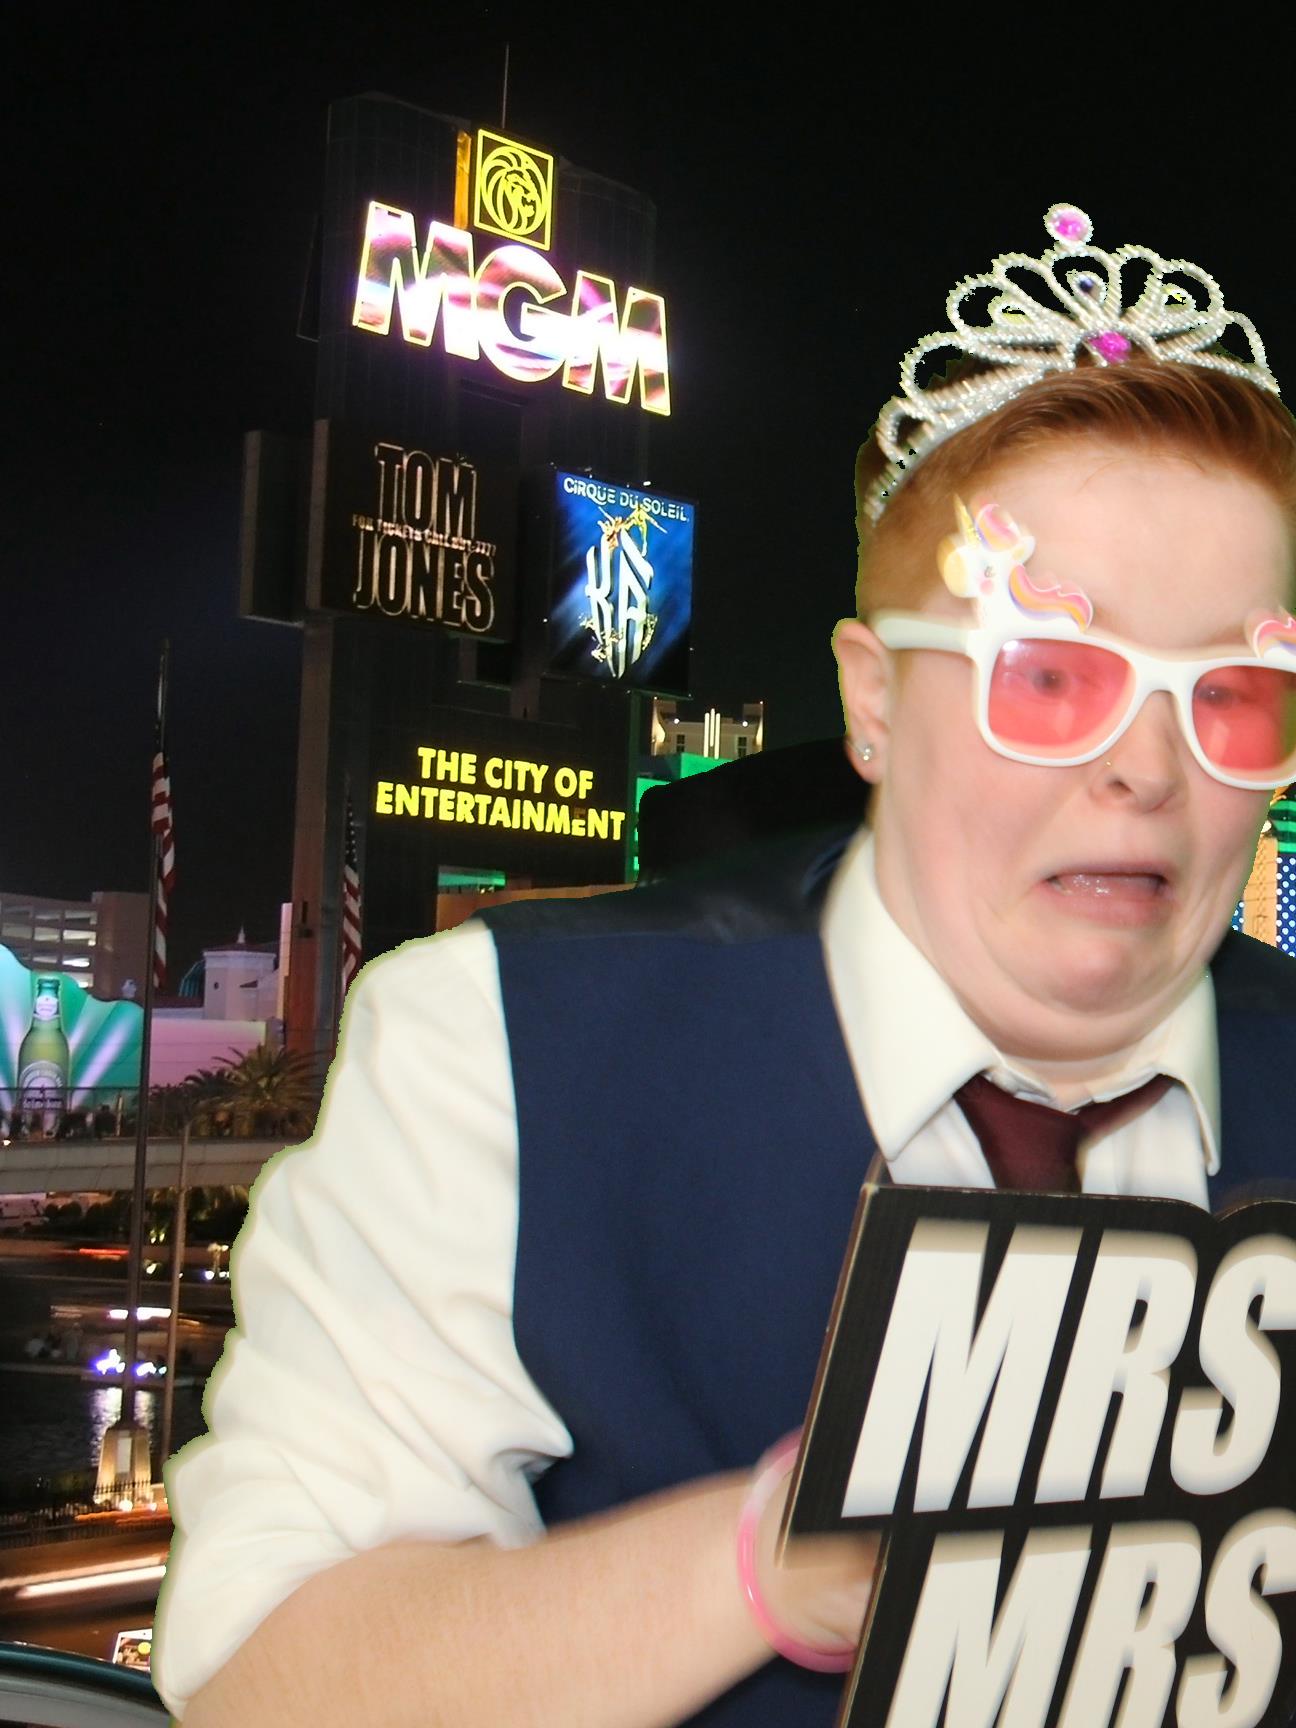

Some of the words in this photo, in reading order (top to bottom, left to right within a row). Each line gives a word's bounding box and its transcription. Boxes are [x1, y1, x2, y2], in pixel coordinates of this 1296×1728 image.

[352, 201, 670, 415] MGM
[374, 442, 477, 540] TOM
[563, 477, 616, 505] CIRQUE
[619, 492, 639, 509] DU
[640, 497, 687, 521] SOLEIL
[377, 518, 423, 541] TICKETS
[353, 530, 495, 632] JONES
[418, 747, 477, 784] THE
[484, 757, 549, 793] CITY
[554, 767, 594, 799] OF
[376, 781, 626, 840] ENTERTAINMENT
